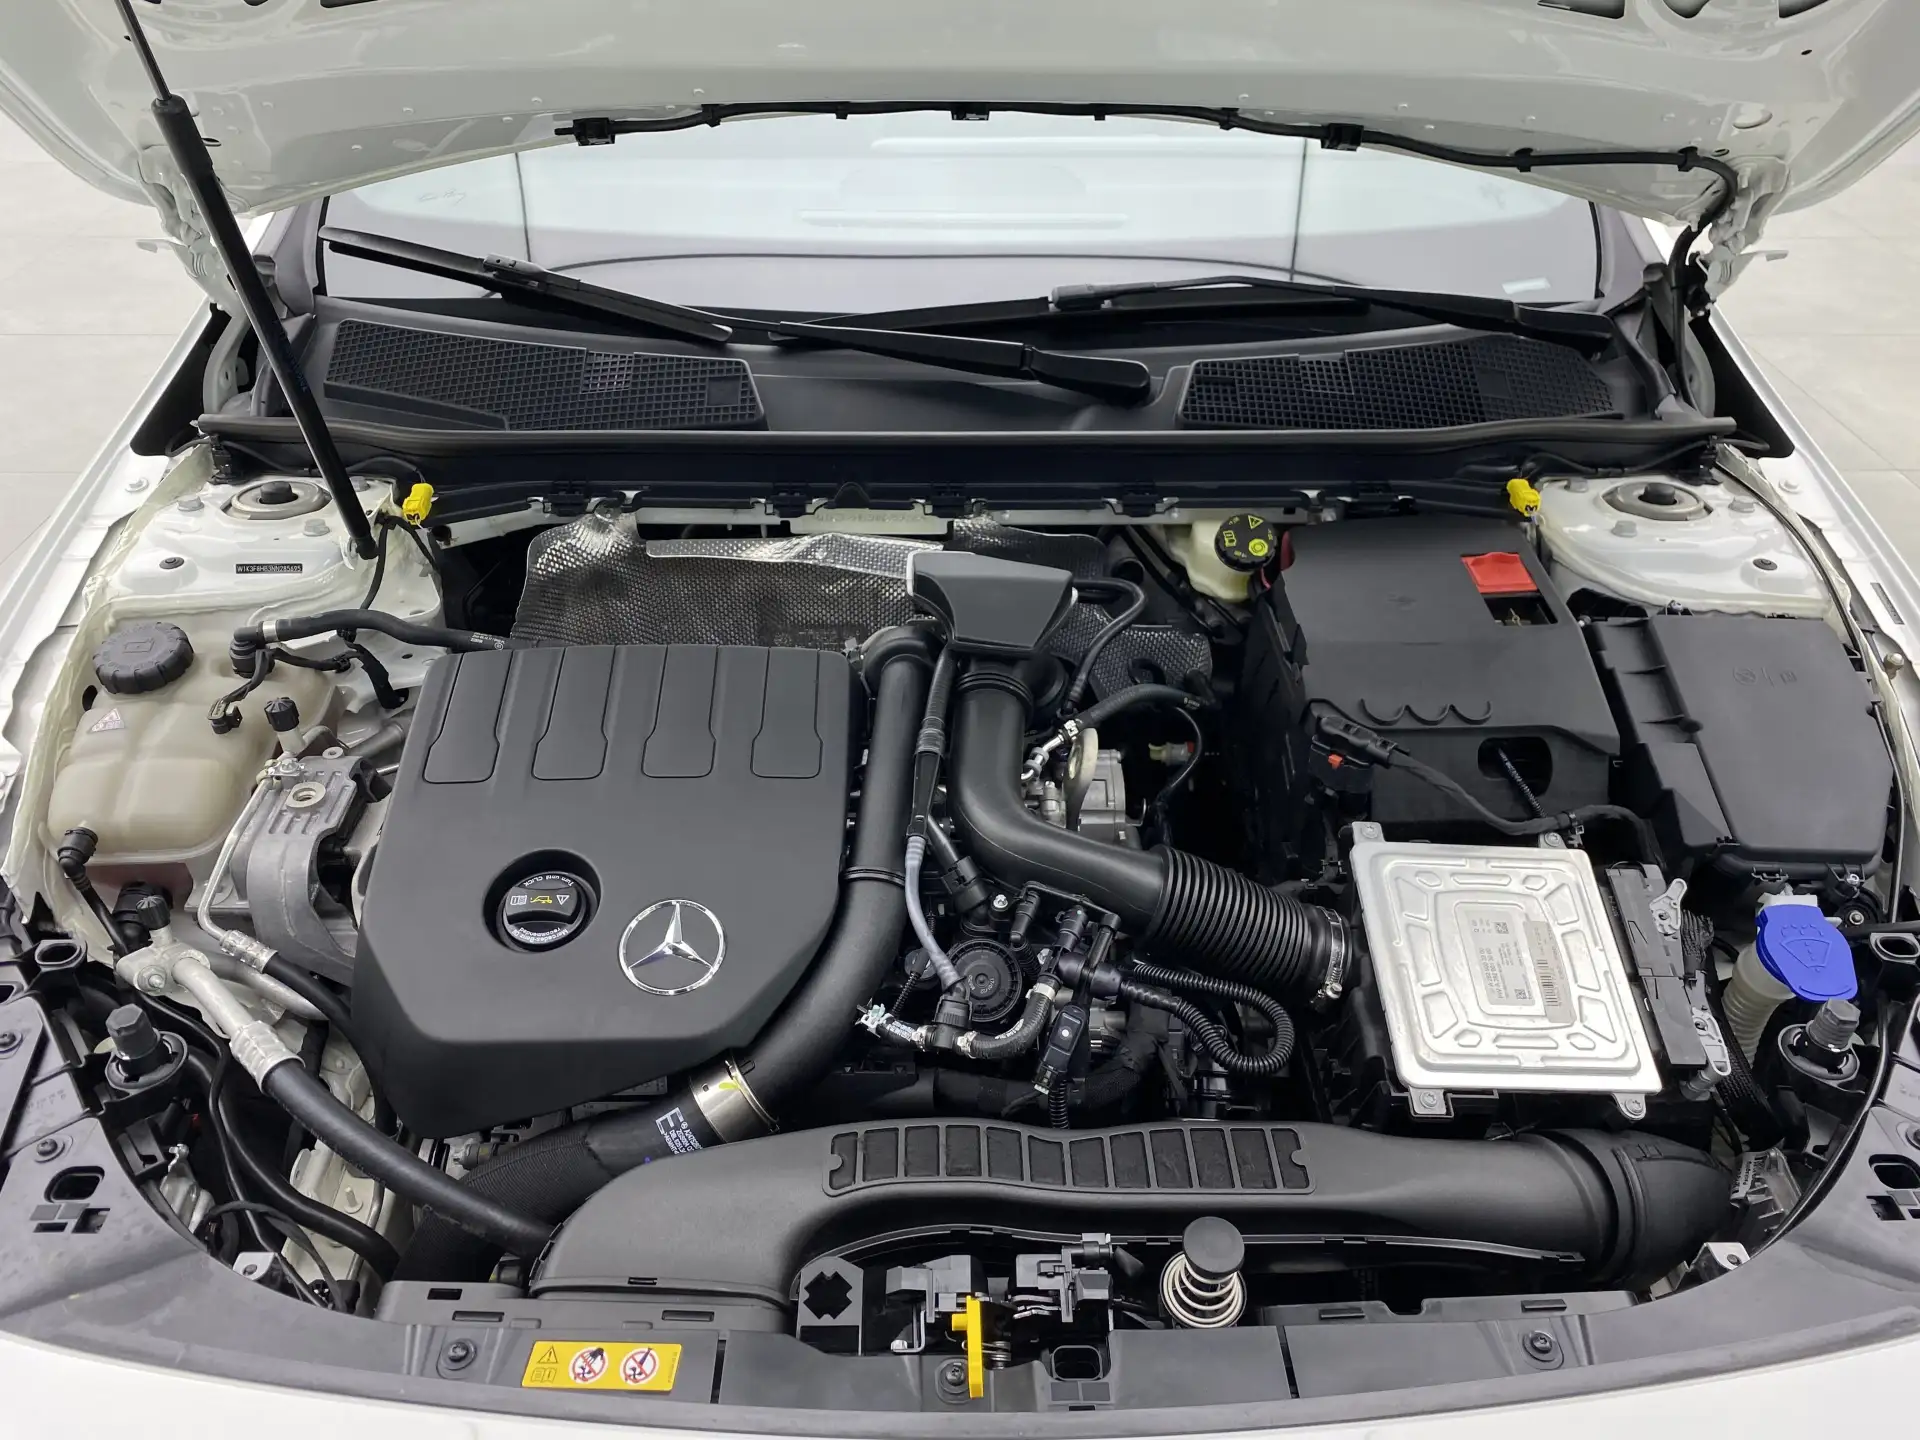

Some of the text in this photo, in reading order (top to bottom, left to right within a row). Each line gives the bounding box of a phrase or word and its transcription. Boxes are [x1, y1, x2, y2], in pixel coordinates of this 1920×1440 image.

[523, 876, 543, 887] CLICK
[561, 876, 574, 887] Turn
[519, 927, 561, 937] recommended
[520, 928, 569, 943] Mercedes-Benz
